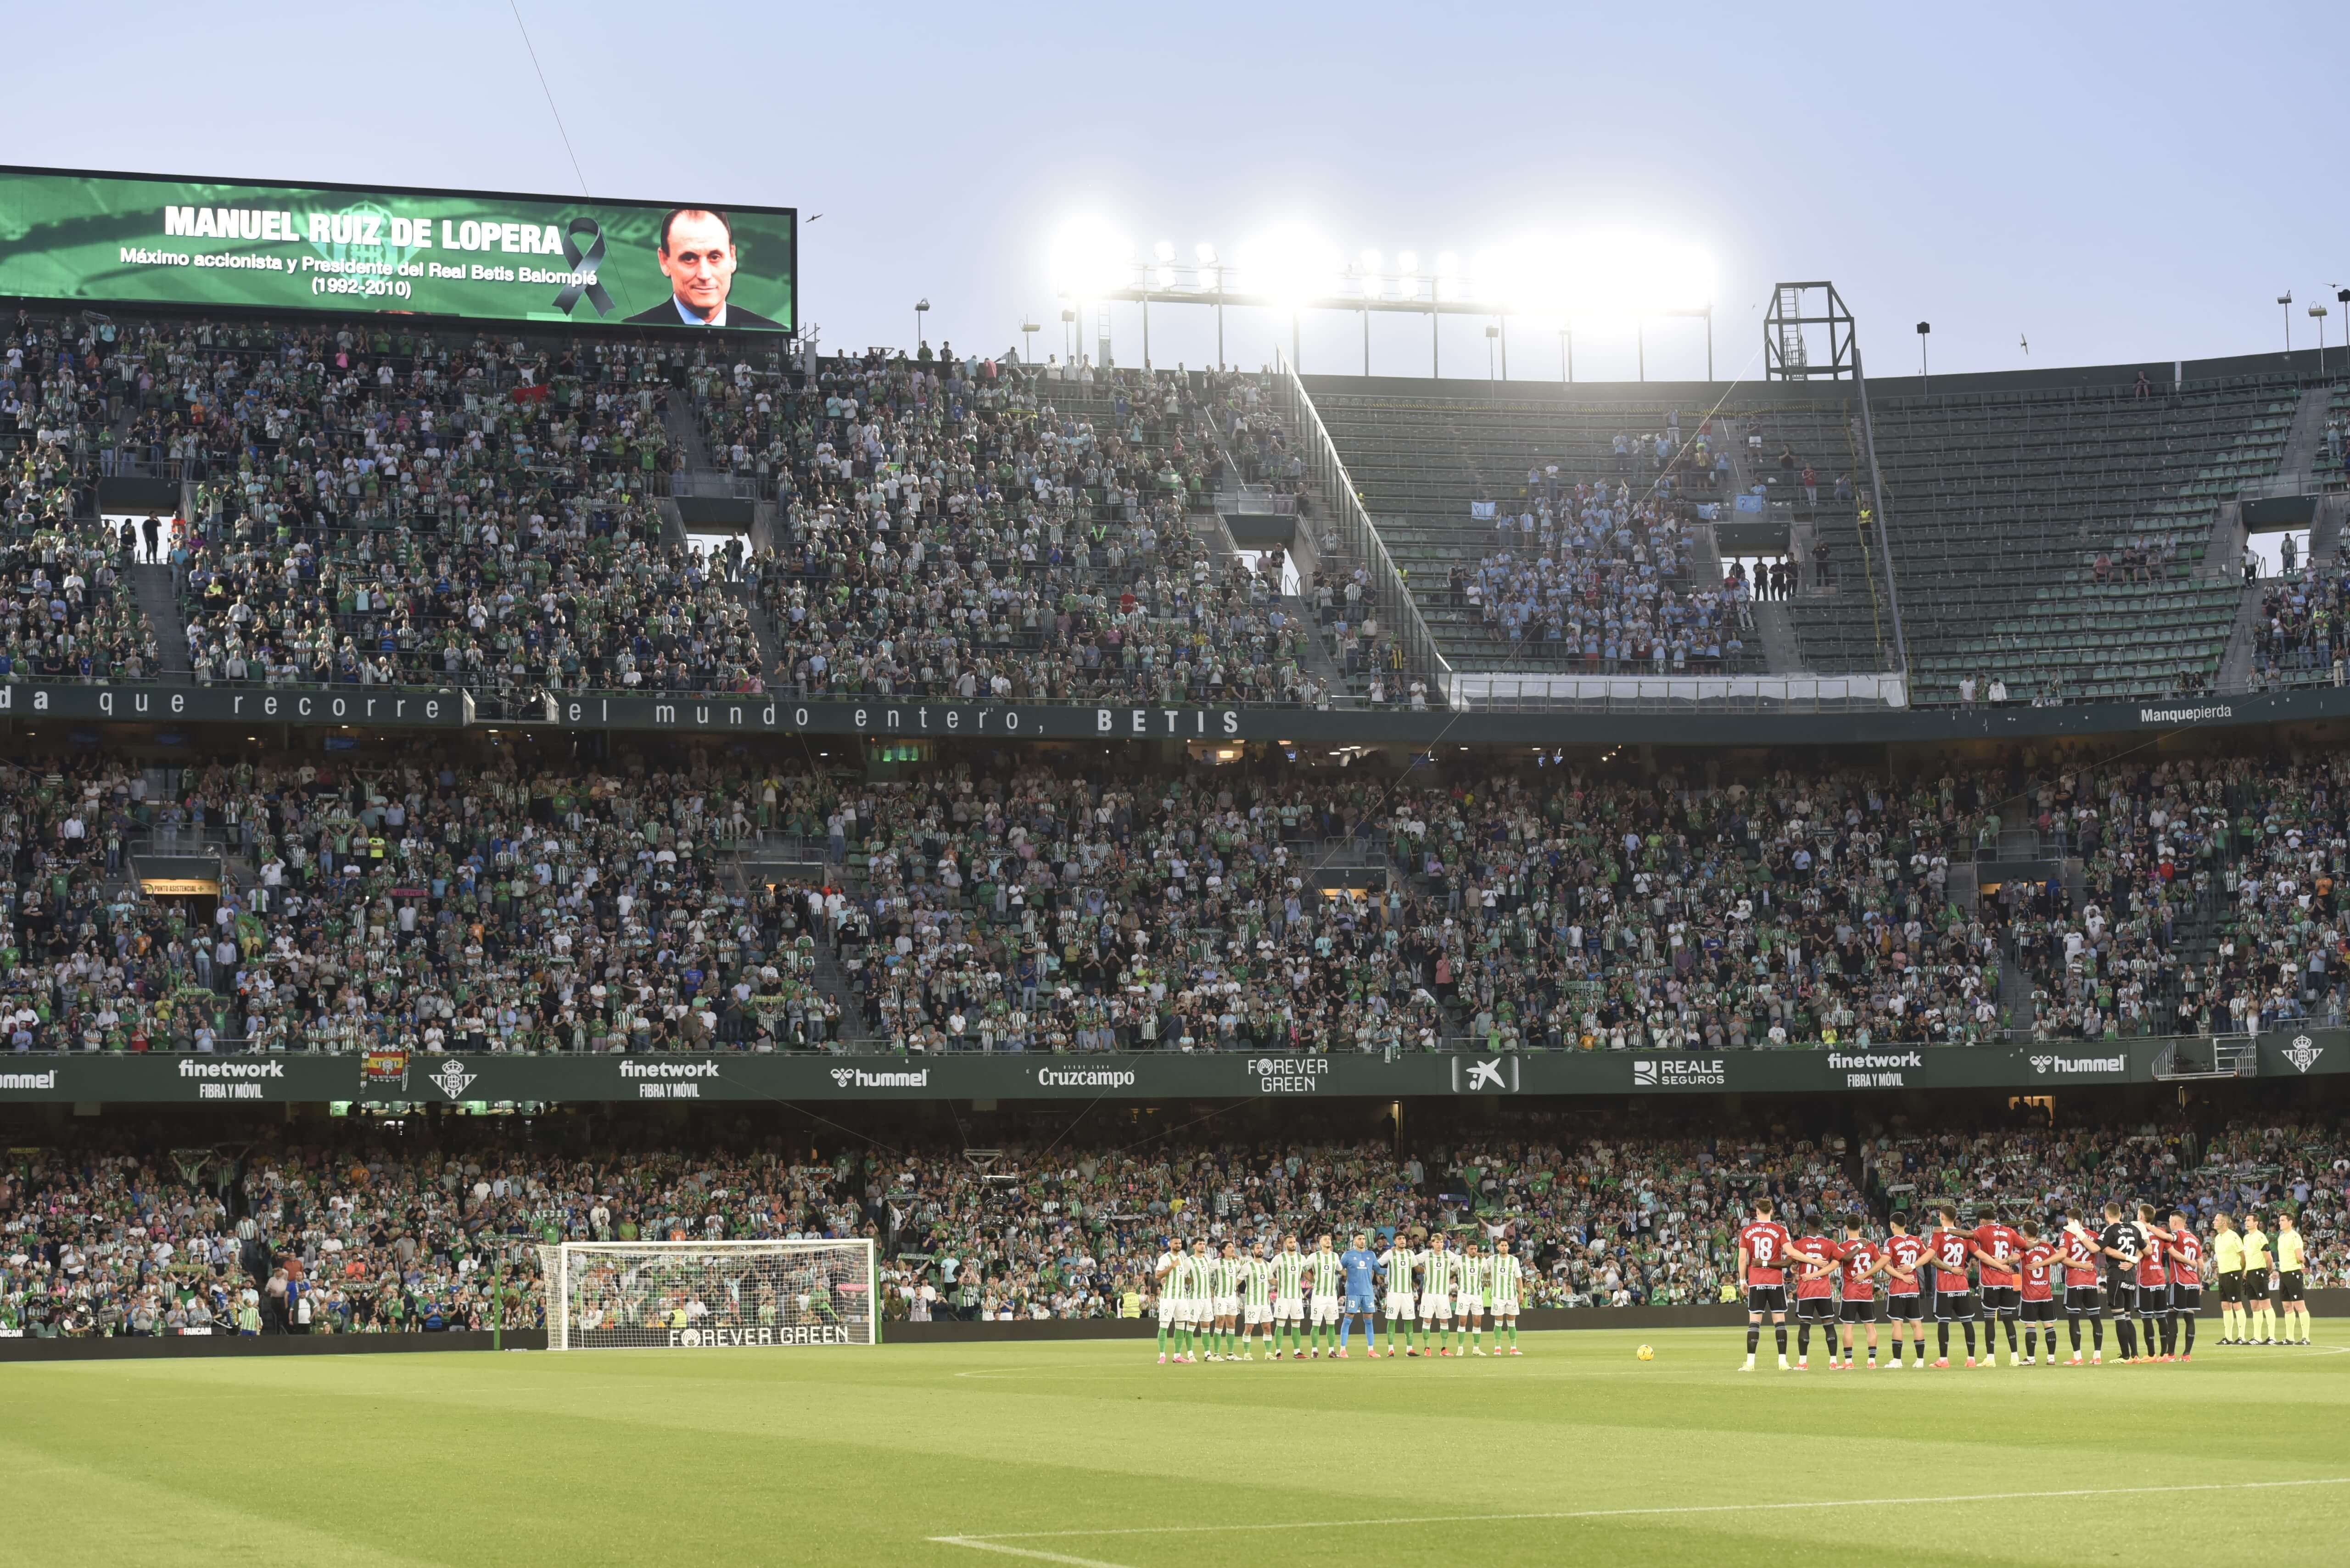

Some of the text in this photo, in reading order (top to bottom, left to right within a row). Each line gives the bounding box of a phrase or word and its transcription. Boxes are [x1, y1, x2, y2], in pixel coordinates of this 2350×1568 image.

[166, 206, 564, 255] MANUEL RUIZ DE LOPERA
[120, 247, 597, 287] Máximo accionista y Presidente del Real Betis Balompié
[312, 278, 412, 299] (1992-2010)
[100, 692, 184, 716] que
[235, 695, 439, 718] recorre
[569, 699, 607, 721] el
[656, 703, 808, 725] mundo
[1097, 709, 1237, 733] BETIS
[2141, 704, 2232, 724] Manquepierda
[179, 1060, 284, 1077] finetwork
[619, 1060, 719, 1077] finetwork
[1248, 1058, 1328, 1076] FOREVER
[1662, 1060, 1724, 1074] REALE
[1827, 1051, 1922, 1069] finetwork
[2054, 1055, 2124, 1072] hummel
[0, 1070, 54, 1088] mmel
[856, 1069, 926, 1087] hummel
[1038, 1067, 1135, 1088] Cruzcampo
[1261, 1077, 1315, 1092] GREEN
[1662, 1075, 1724, 1085] SEGUROS
[1847, 1071, 1903, 1087] FIBRA Y MÓVIL
[200, 1082, 263, 1098] FIBRA Y MÓVIL
[640, 1081, 699, 1097] FIBRA Y MÓVIL
[1752, 1236, 1773, 1261] 18
[1943, 1243, 1964, 1267] 28
[1993, 1240, 2009, 1260] 16
[2118, 1236, 2135, 1256] 25
[2183, 1245, 2196, 1261] 10
[1851, 1253, 1871, 1277] 33
[2032, 1255, 2043, 1278] 8
[178, 1327, 212, 1335] #FANCAM
[781, 1326, 849, 1345] GREEN
